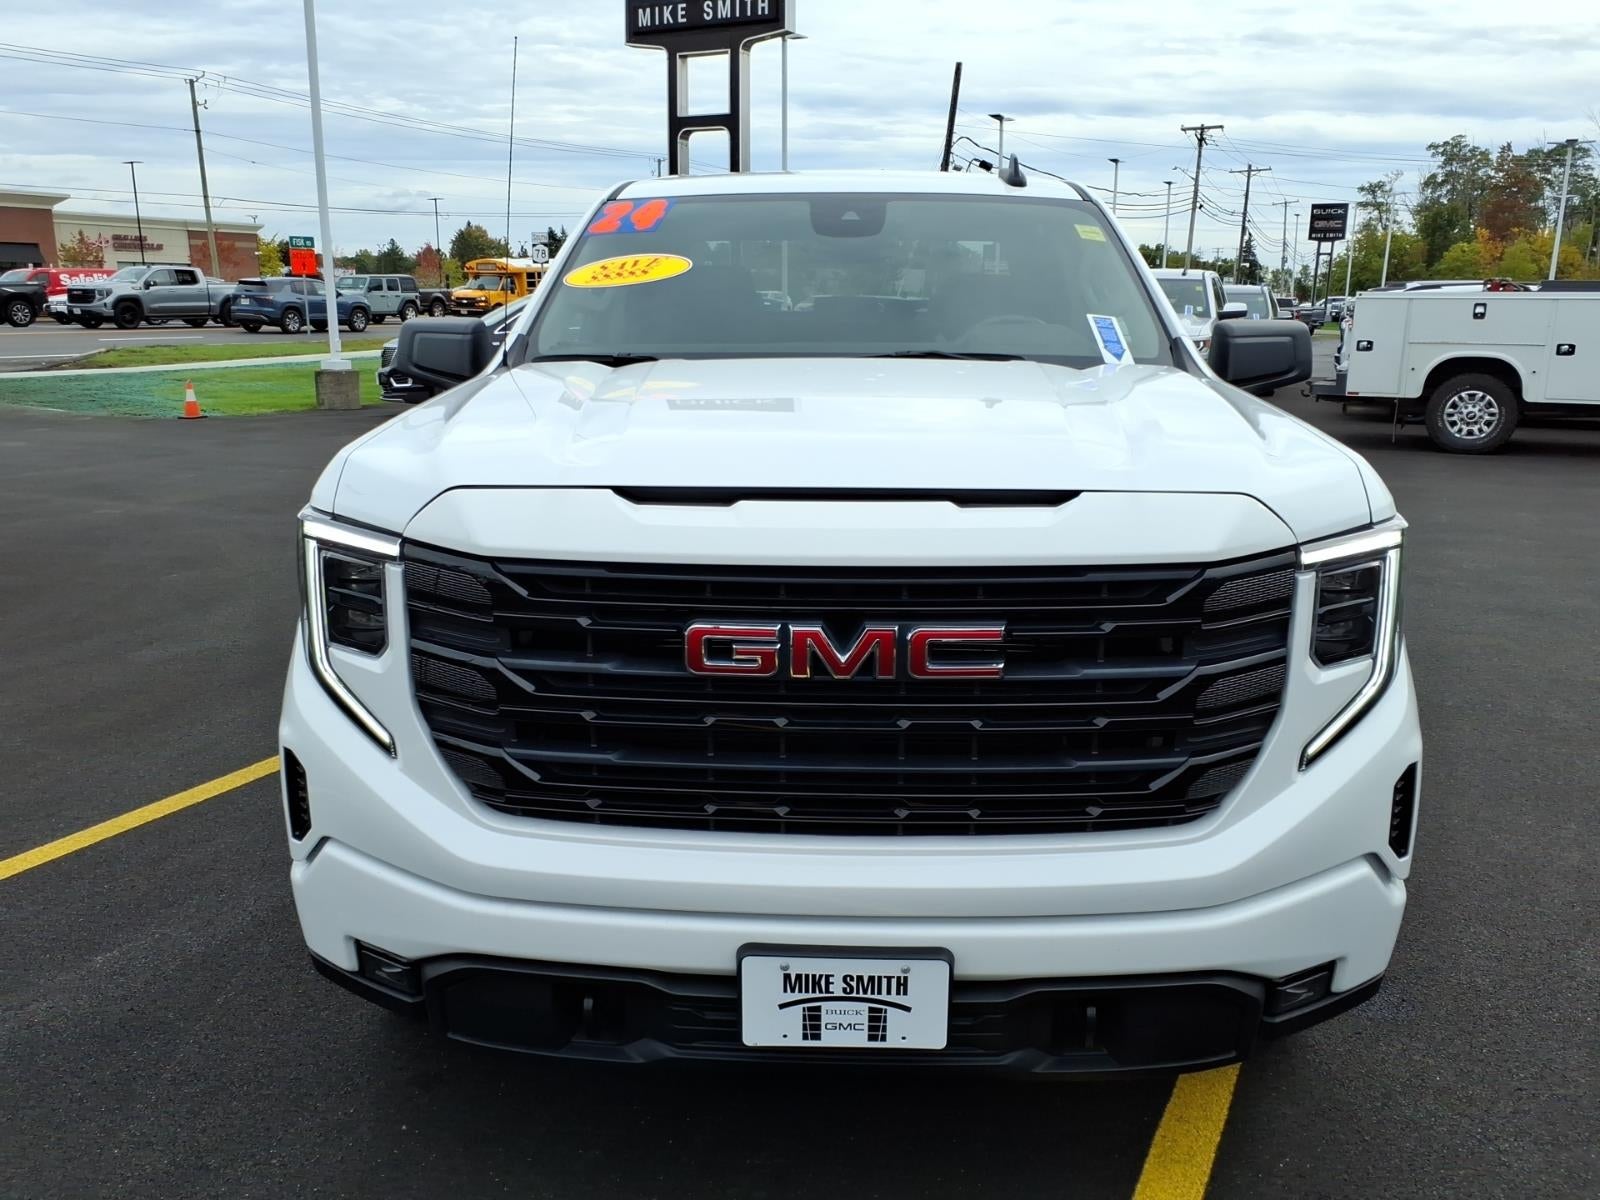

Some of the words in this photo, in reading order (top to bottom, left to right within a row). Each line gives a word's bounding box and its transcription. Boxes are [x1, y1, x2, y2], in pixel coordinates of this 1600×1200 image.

[638, 4, 687, 27] MIKE
[703, 0, 768, 20] SMITH
[1314, 220, 1343, 228] GMC
[534, 248, 547, 259] 78
[59, 273, 107, 286] Safelit
[684, 622, 1006, 679] GMC
[782, 973, 835, 995] MIKE
[841, 974, 909, 996] SMITH
[825, 1008, 864, 1016] BUICK
[824, 1022, 865, 1031] GMC
